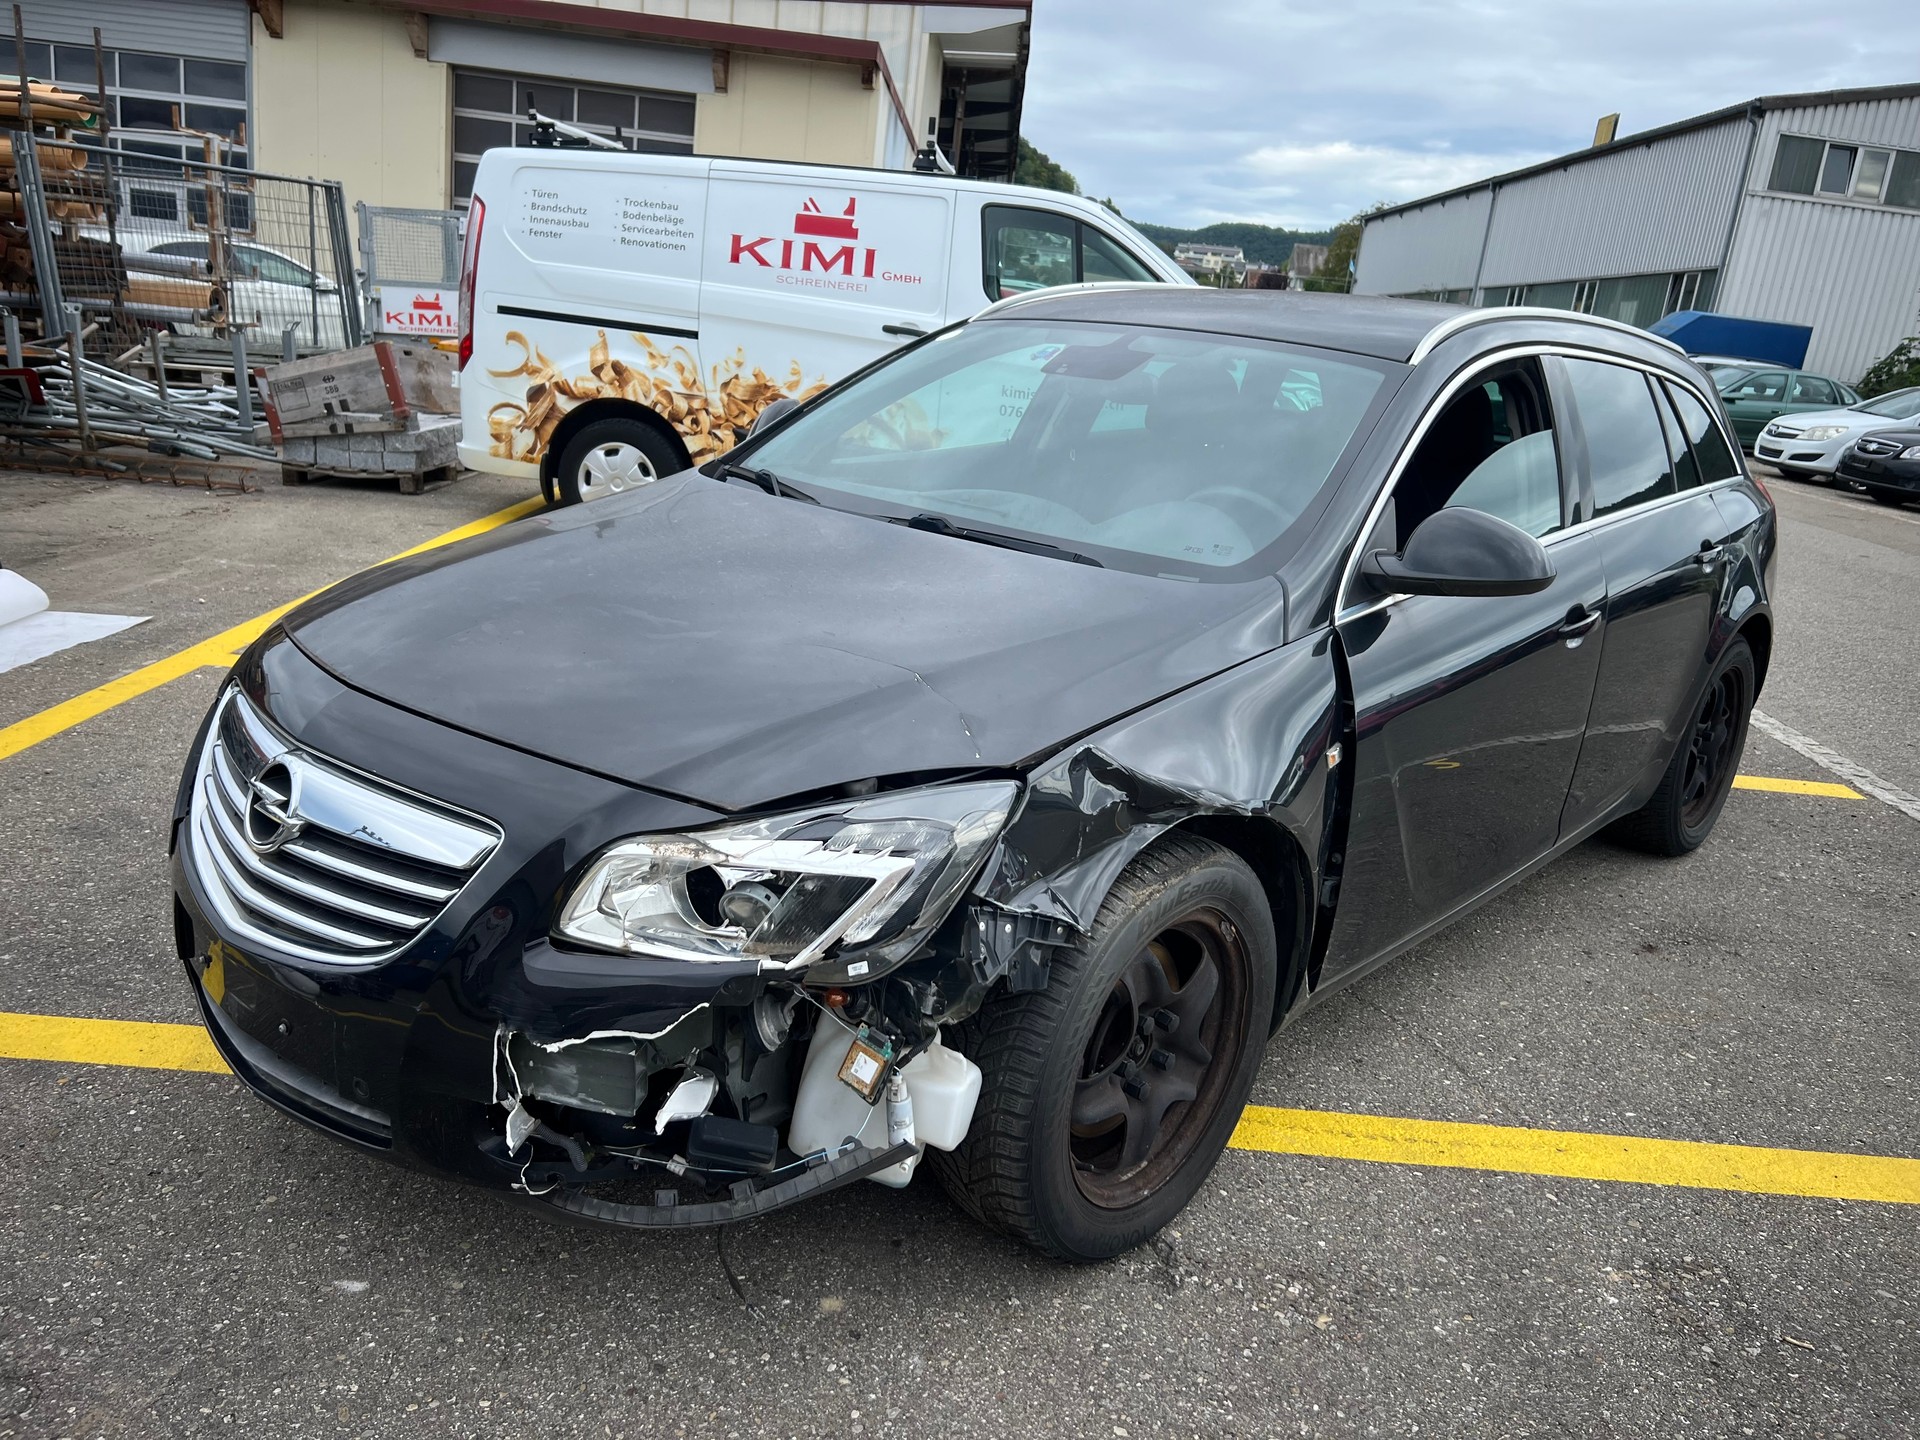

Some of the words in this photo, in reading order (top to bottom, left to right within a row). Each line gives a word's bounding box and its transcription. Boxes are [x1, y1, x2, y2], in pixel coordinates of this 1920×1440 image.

[532, 189, 559, 200] Türen
[531, 202, 588, 215] Brandschutz
[624, 198, 680, 211] Trockenbau
[530, 215, 590, 228] Innenausbau
[622, 211, 685, 226] Bodenbeläge
[528, 228, 563, 239] Fenster
[621, 224, 695, 239] Servicearbeiten
[620, 237, 686, 251] Renovationen
[728, 233, 878, 279] KIMI
[776, 275, 868, 293] SCHREINEREI
[386, 311, 452, 327] KIMI
[398, 326, 459, 334] SCHREINERE
